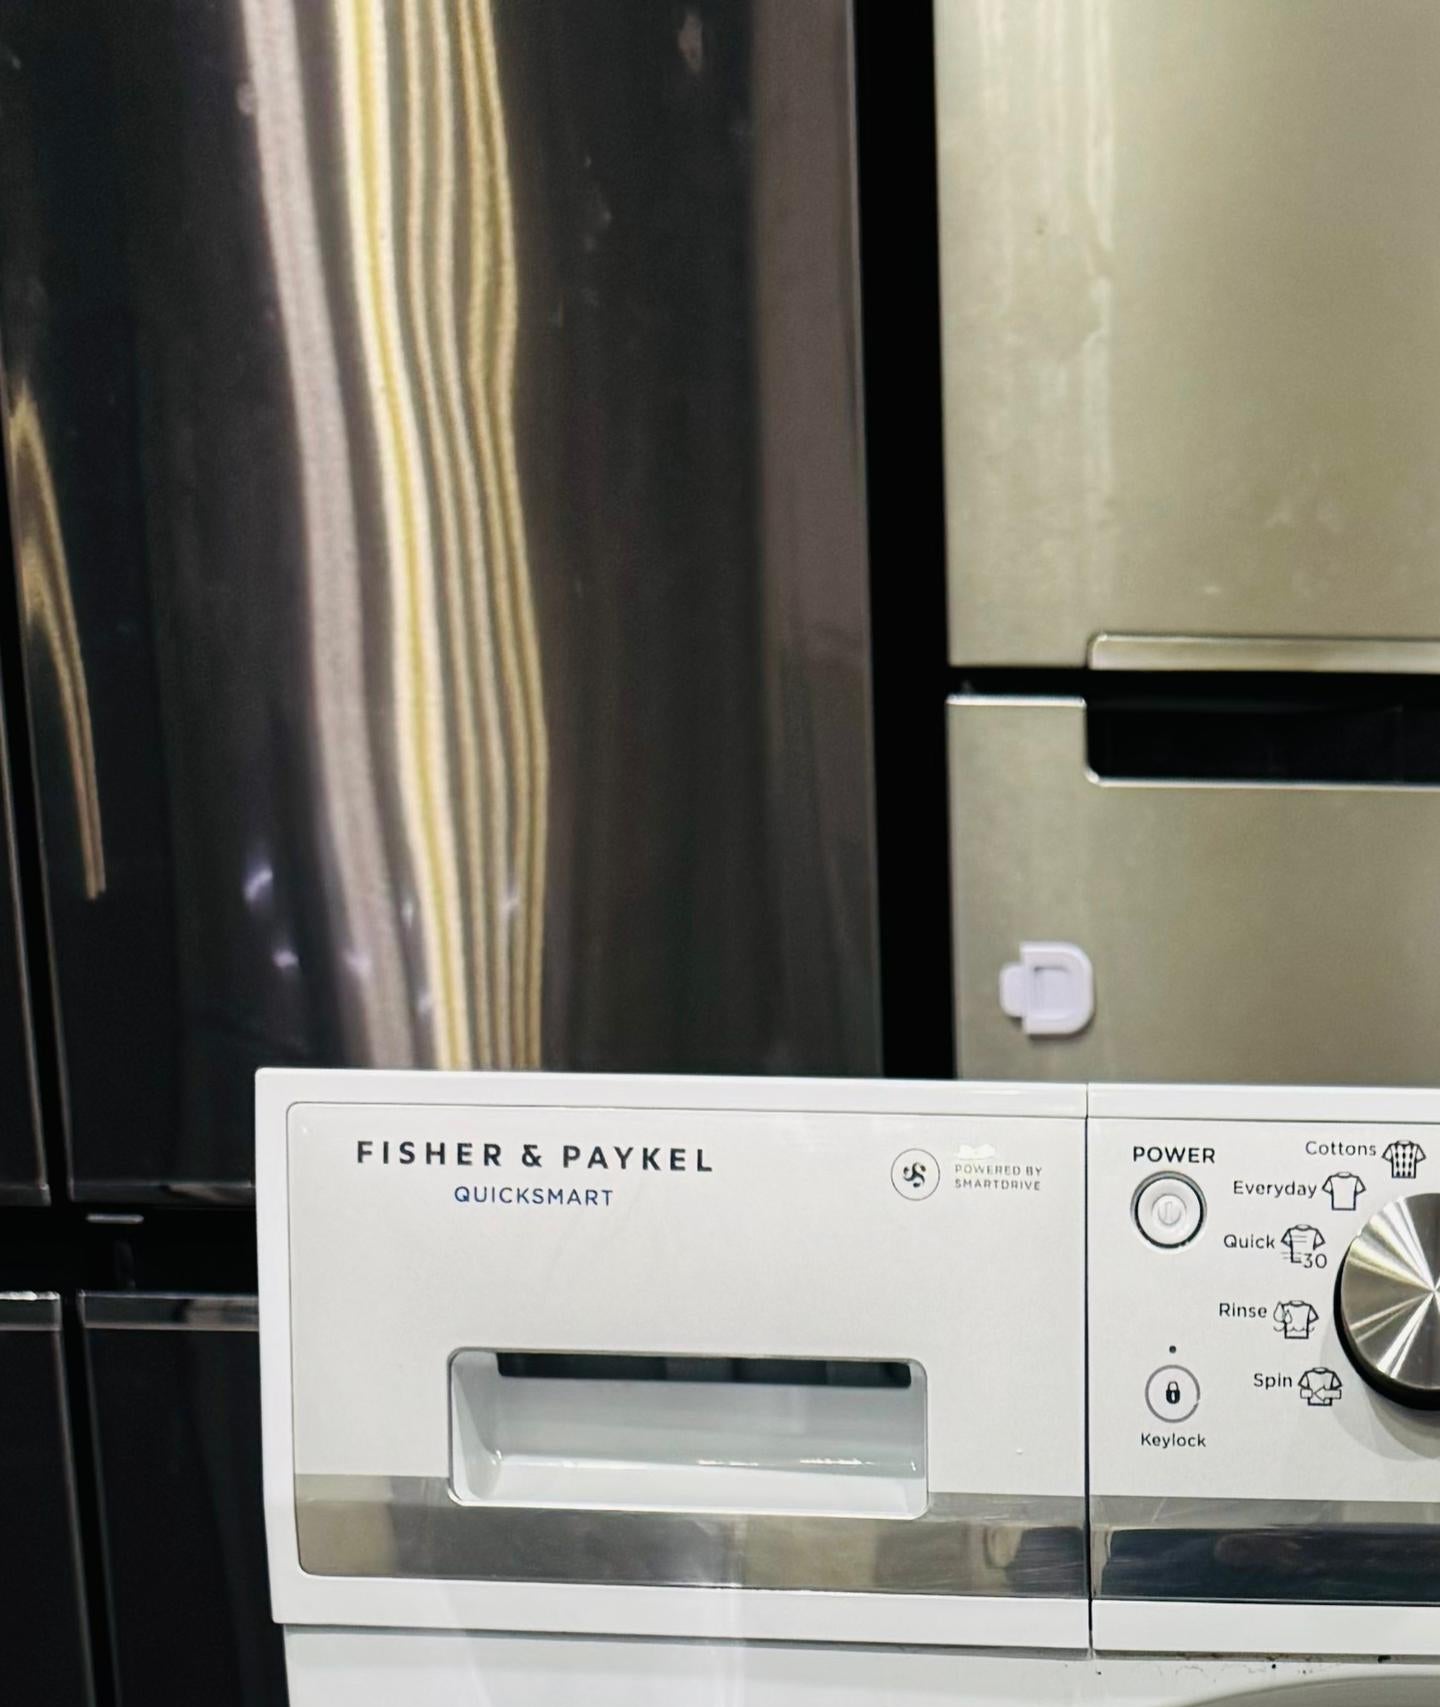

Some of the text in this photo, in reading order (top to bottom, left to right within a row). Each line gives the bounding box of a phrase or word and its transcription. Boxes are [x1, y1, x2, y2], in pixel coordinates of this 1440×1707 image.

[357, 1140, 713, 1172] FISHER & PAYKEL
[1133, 1145, 1216, 1164] POWER
[1305, 1140, 1377, 1157] Cottons
[954, 1164, 1042, 1177] POWERED BY
[954, 1178, 1041, 1192] SMARTDRIVE
[1233, 1180, 1317, 1199] Everyday
[454, 1185, 613, 1207] QUICKSMART
[1223, 1233, 1275, 1250] Quick
[1303, 1252, 1328, 1269] 30
[1219, 1302, 1268, 1319] Rinse
[1253, 1372, 1293, 1390] Spin
[1140, 1432, 1206, 1449] Keylock
